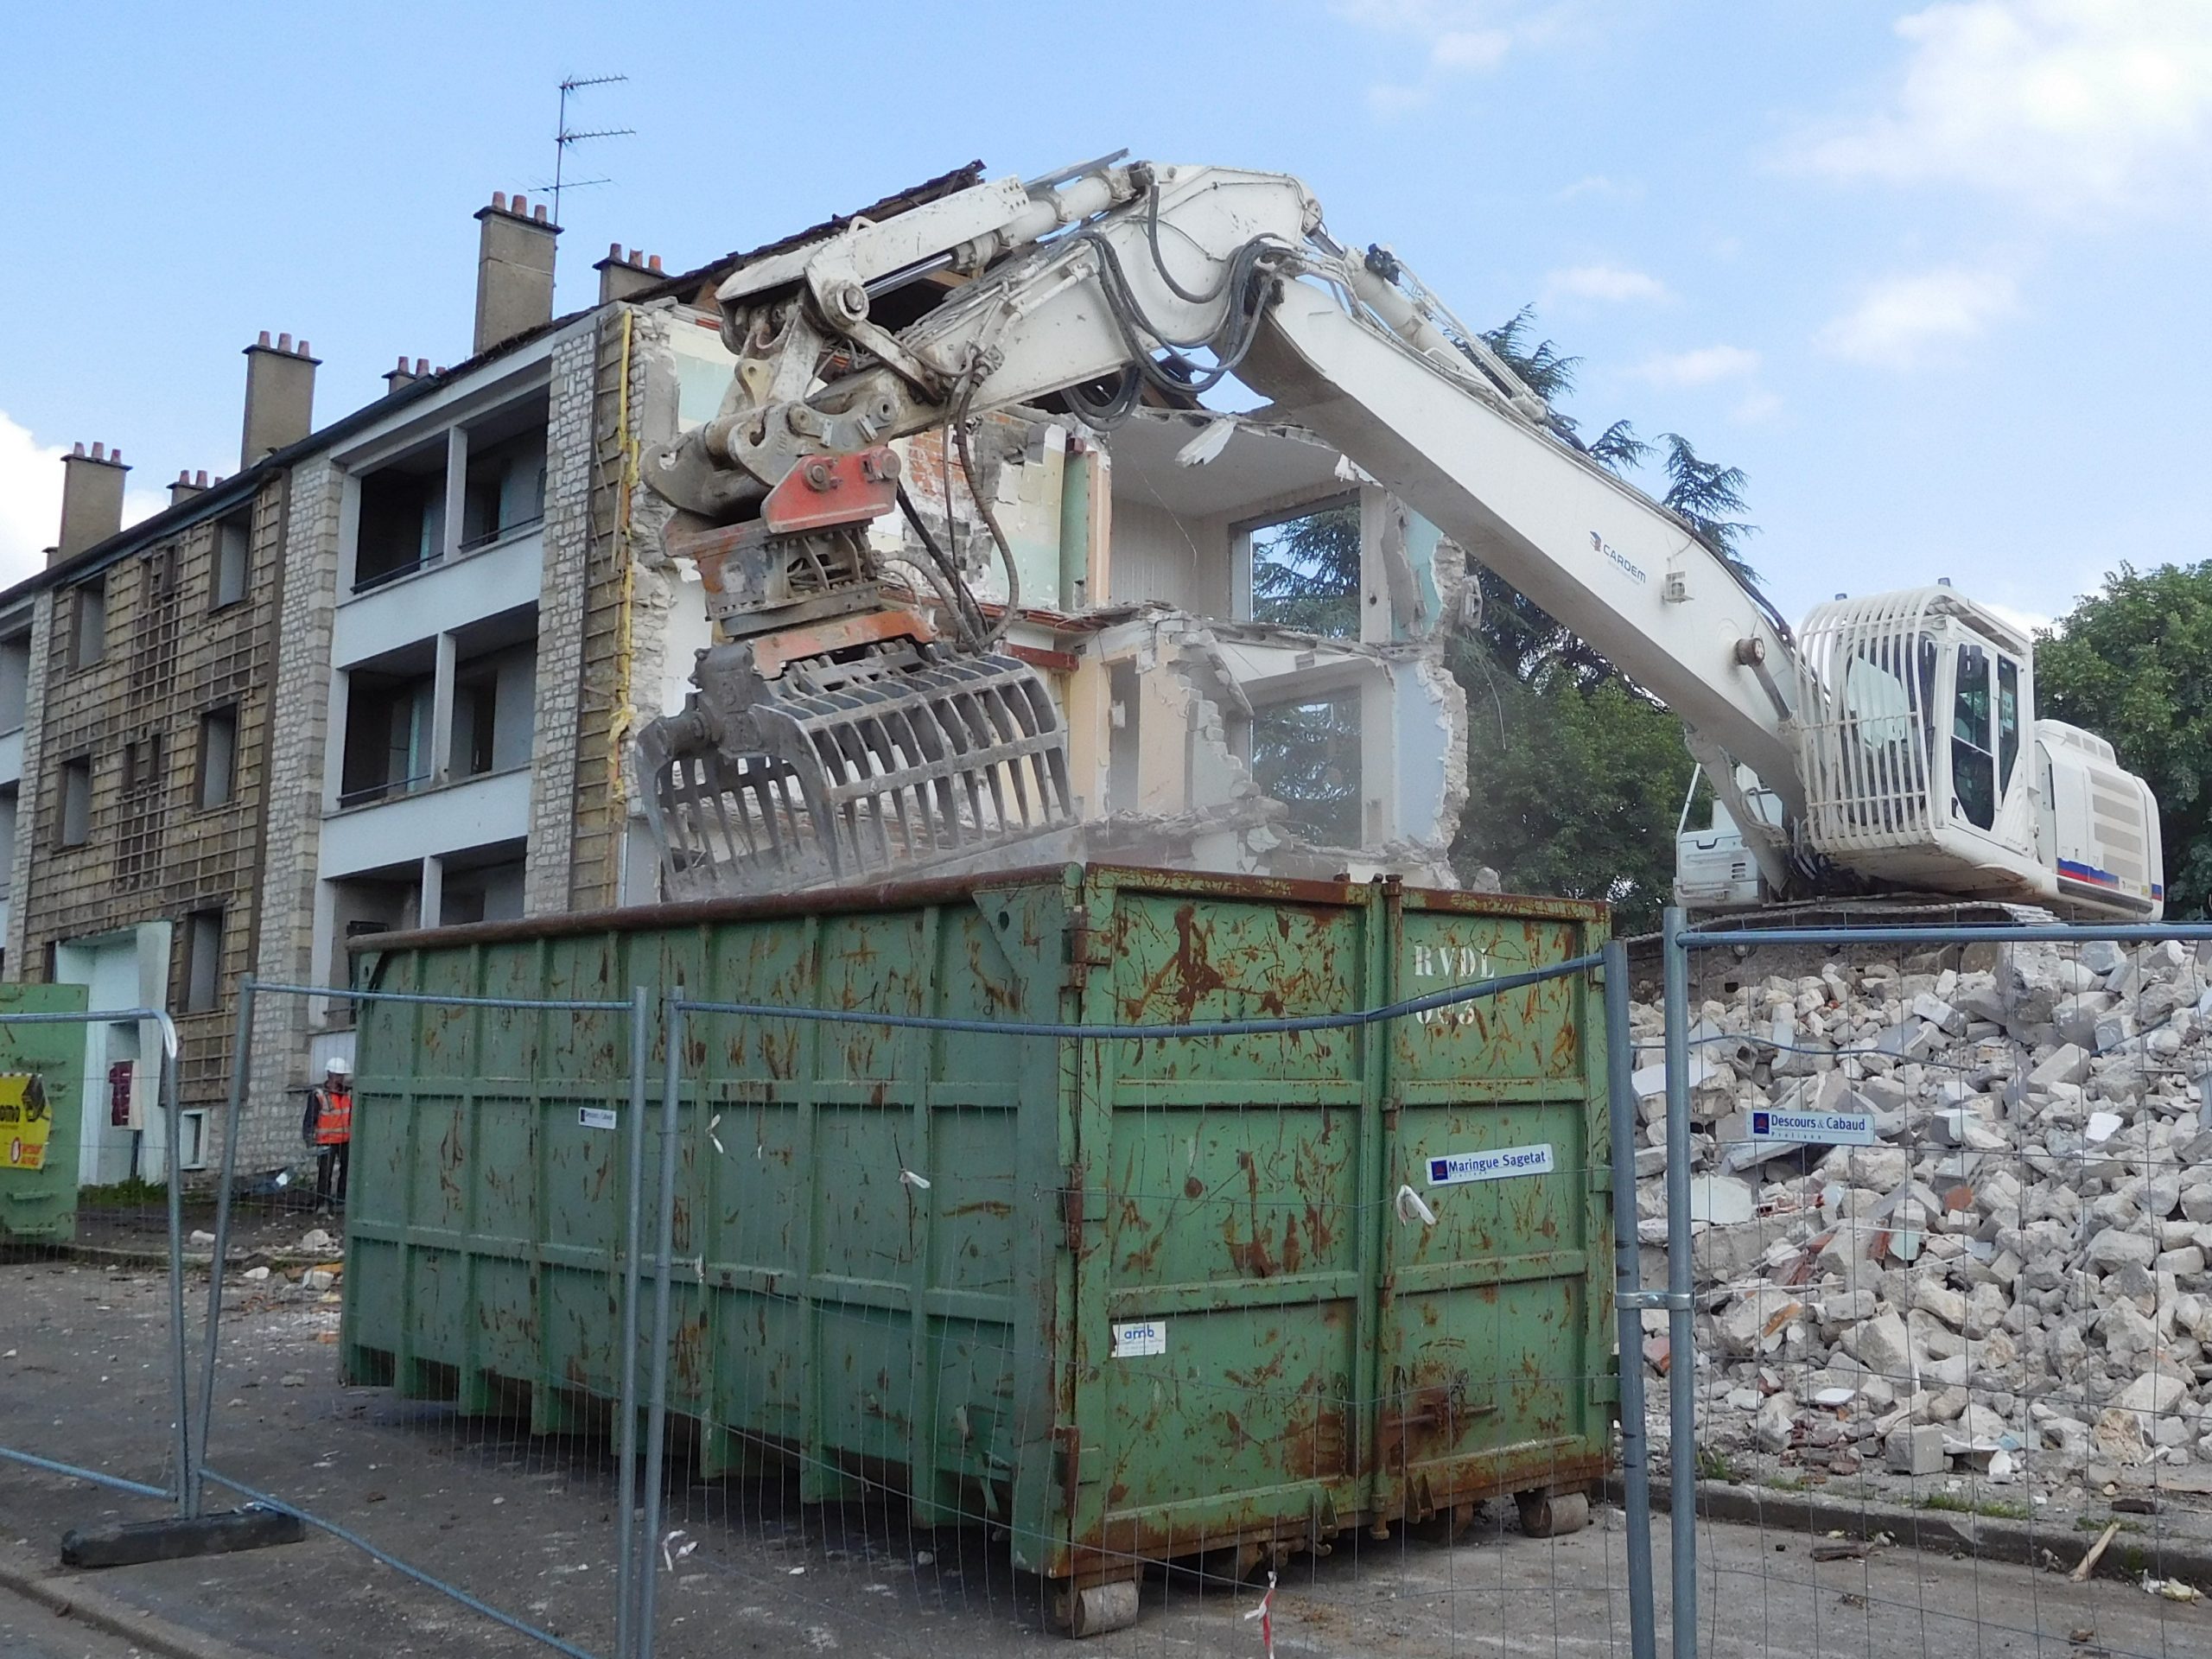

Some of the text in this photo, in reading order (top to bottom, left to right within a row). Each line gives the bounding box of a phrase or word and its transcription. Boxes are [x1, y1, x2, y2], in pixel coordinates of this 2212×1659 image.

[1603, 543, 1646, 583] CARDEM
[1414, 945, 1495, 978] RVDL
[1771, 1115, 1866, 1131] Descours & Cabaud
[1448, 1150, 1546, 1173] Maringue Sagetat
[1124, 1324, 1154, 1339] amb
